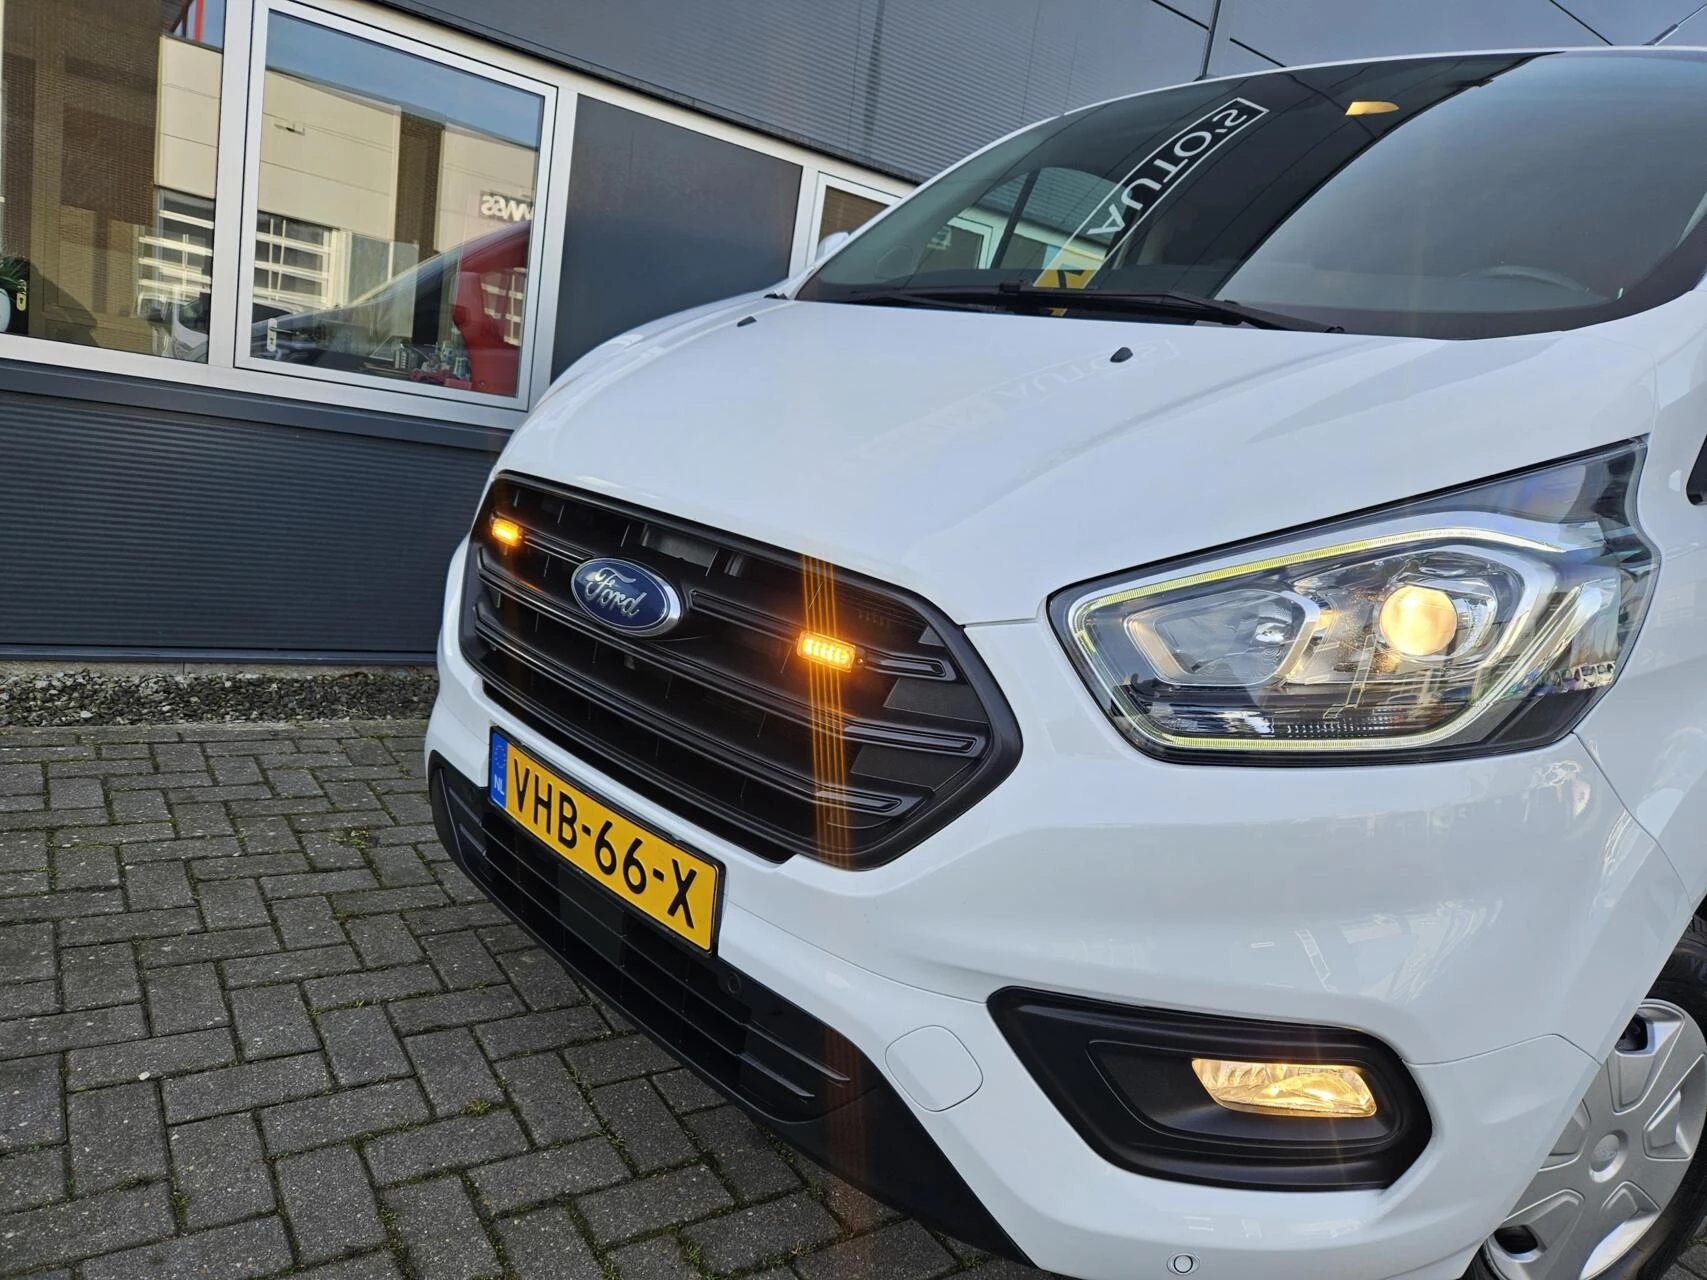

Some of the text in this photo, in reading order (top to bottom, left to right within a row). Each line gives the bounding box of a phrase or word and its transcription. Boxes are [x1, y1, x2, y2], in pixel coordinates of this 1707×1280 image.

[585, 567, 648, 617] Ford
[494, 774, 505, 796] NL
[514, 758, 698, 929] VHB-66-X
